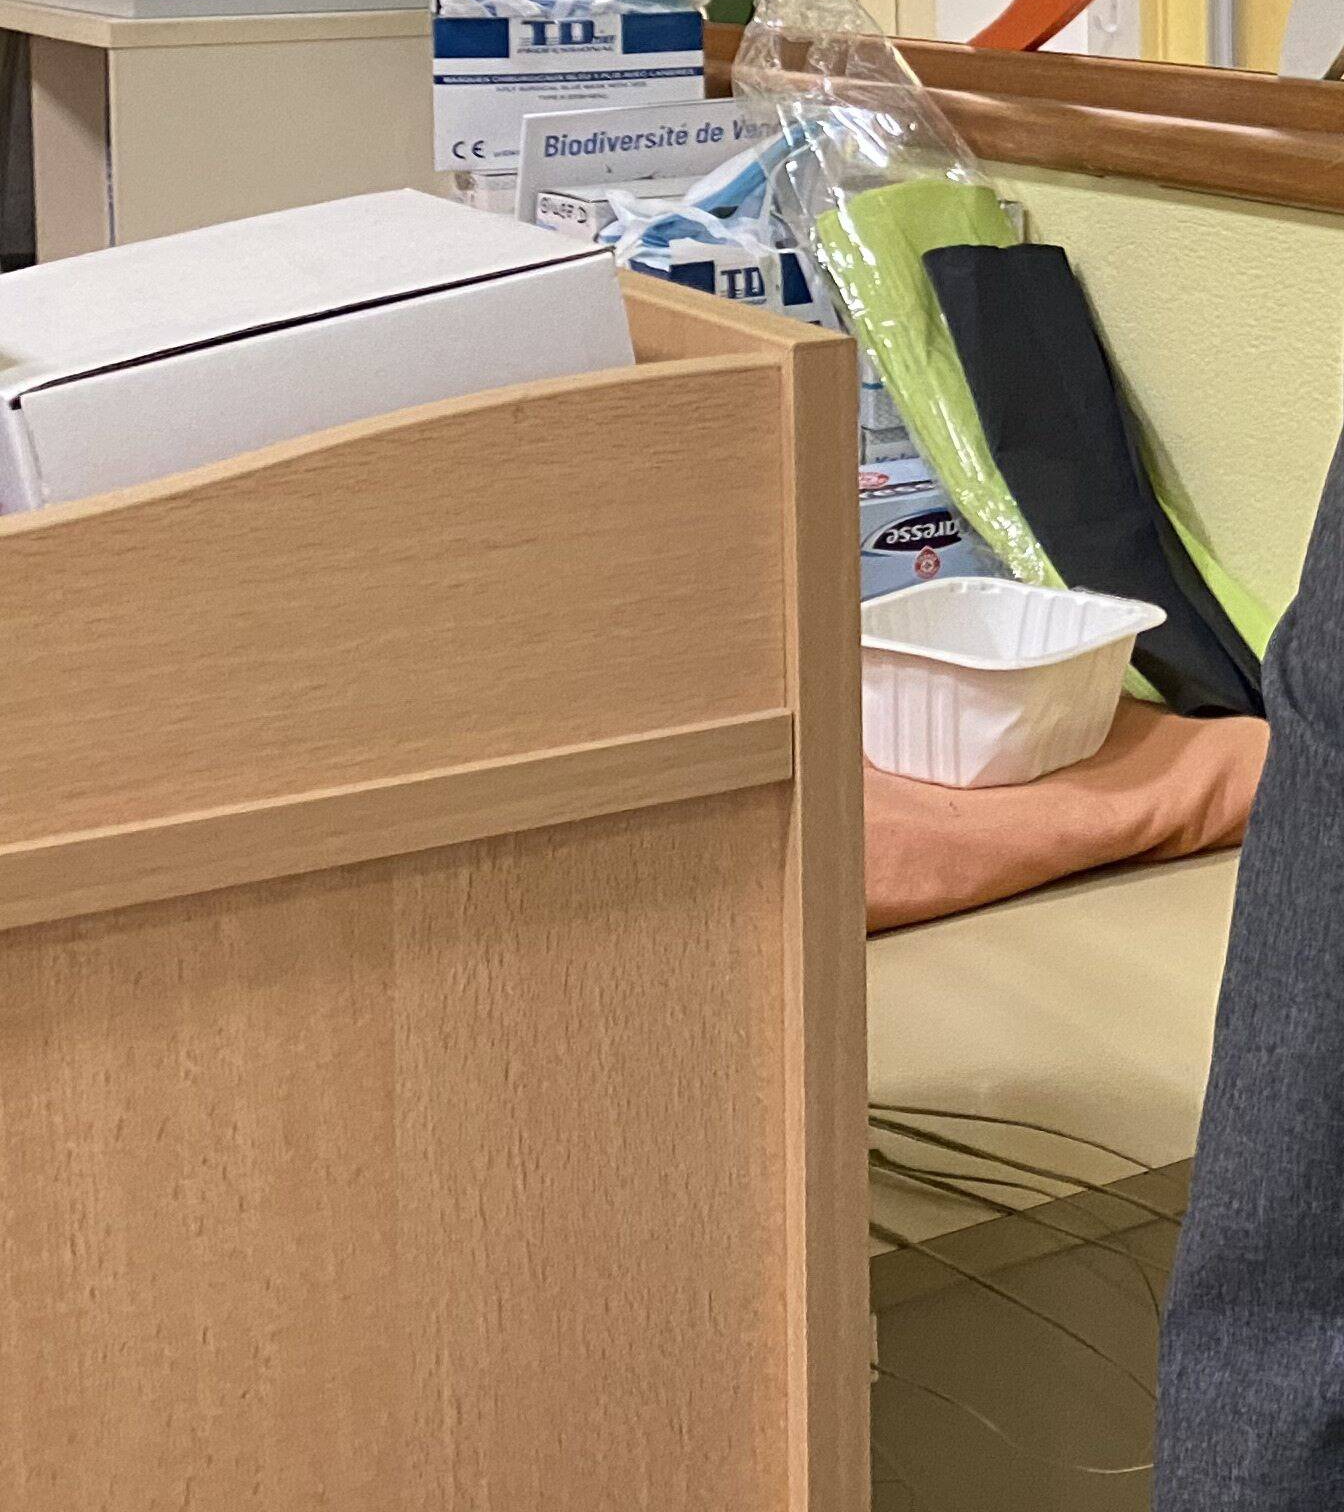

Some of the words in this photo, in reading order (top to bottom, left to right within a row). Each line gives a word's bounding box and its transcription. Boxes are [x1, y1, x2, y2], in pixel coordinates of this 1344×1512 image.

[545, 122, 688, 158] Biodiversité
[696, 122, 724, 143] de
[886, 519, 959, 544] aresse
